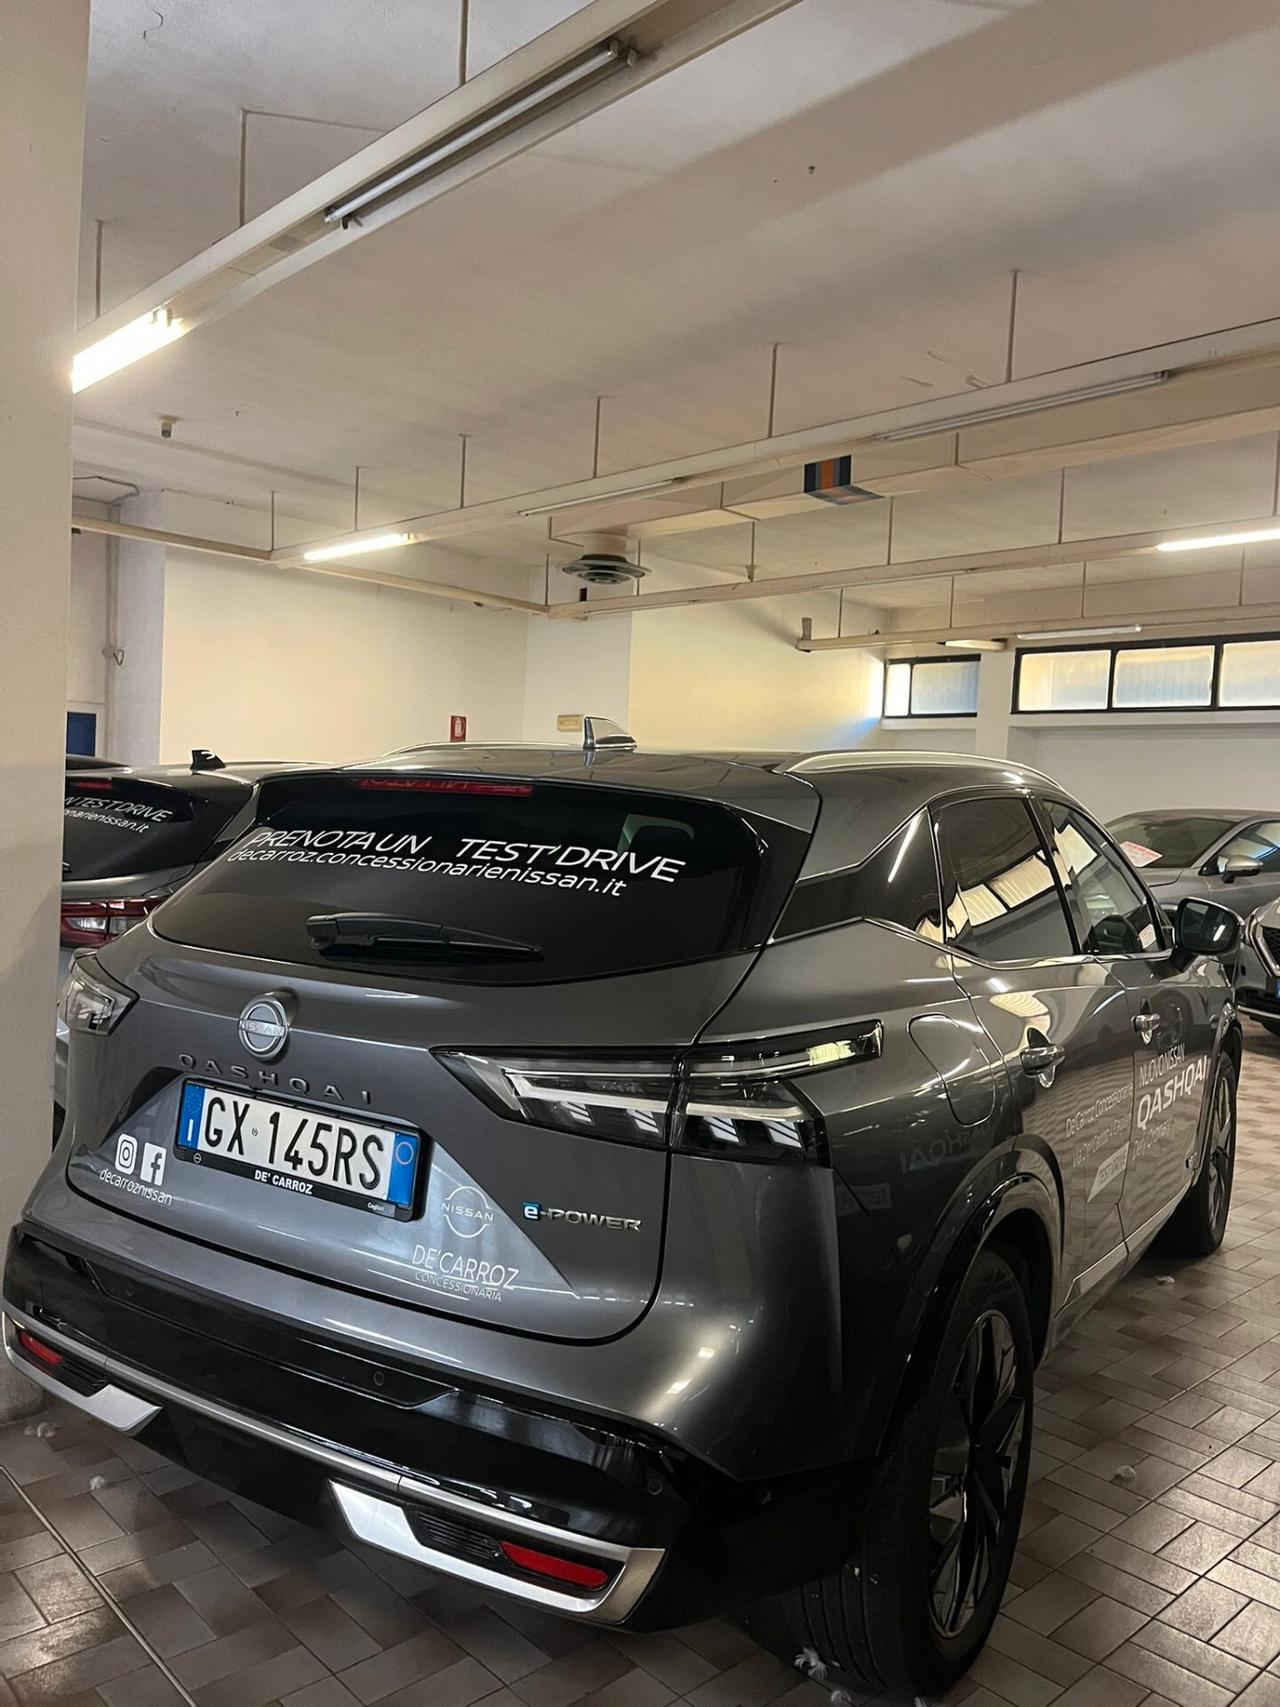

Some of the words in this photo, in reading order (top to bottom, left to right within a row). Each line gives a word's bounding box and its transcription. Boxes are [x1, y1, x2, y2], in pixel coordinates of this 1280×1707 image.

[247, 829, 377, 850] PRENOTA
[375, 833, 432, 855] UN
[227, 848, 628, 897] decarroz.concessionarienissan.it
[178, 1053, 372, 1104] QASHQAI
[1137, 1054, 1207, 1131] QASHQAI
[204, 1096, 250, 1156] GX
[268, 1111, 384, 1191] 145RS
[99, 1168, 173, 1206] decarroznissan
[271, 1174, 314, 1195] CARROZ
[441, 1202, 495, 1222] NISSAN
[522, 1203, 642, 1232] e-POWER
[415, 1271, 502, 1303] CONCESSIONARIA
